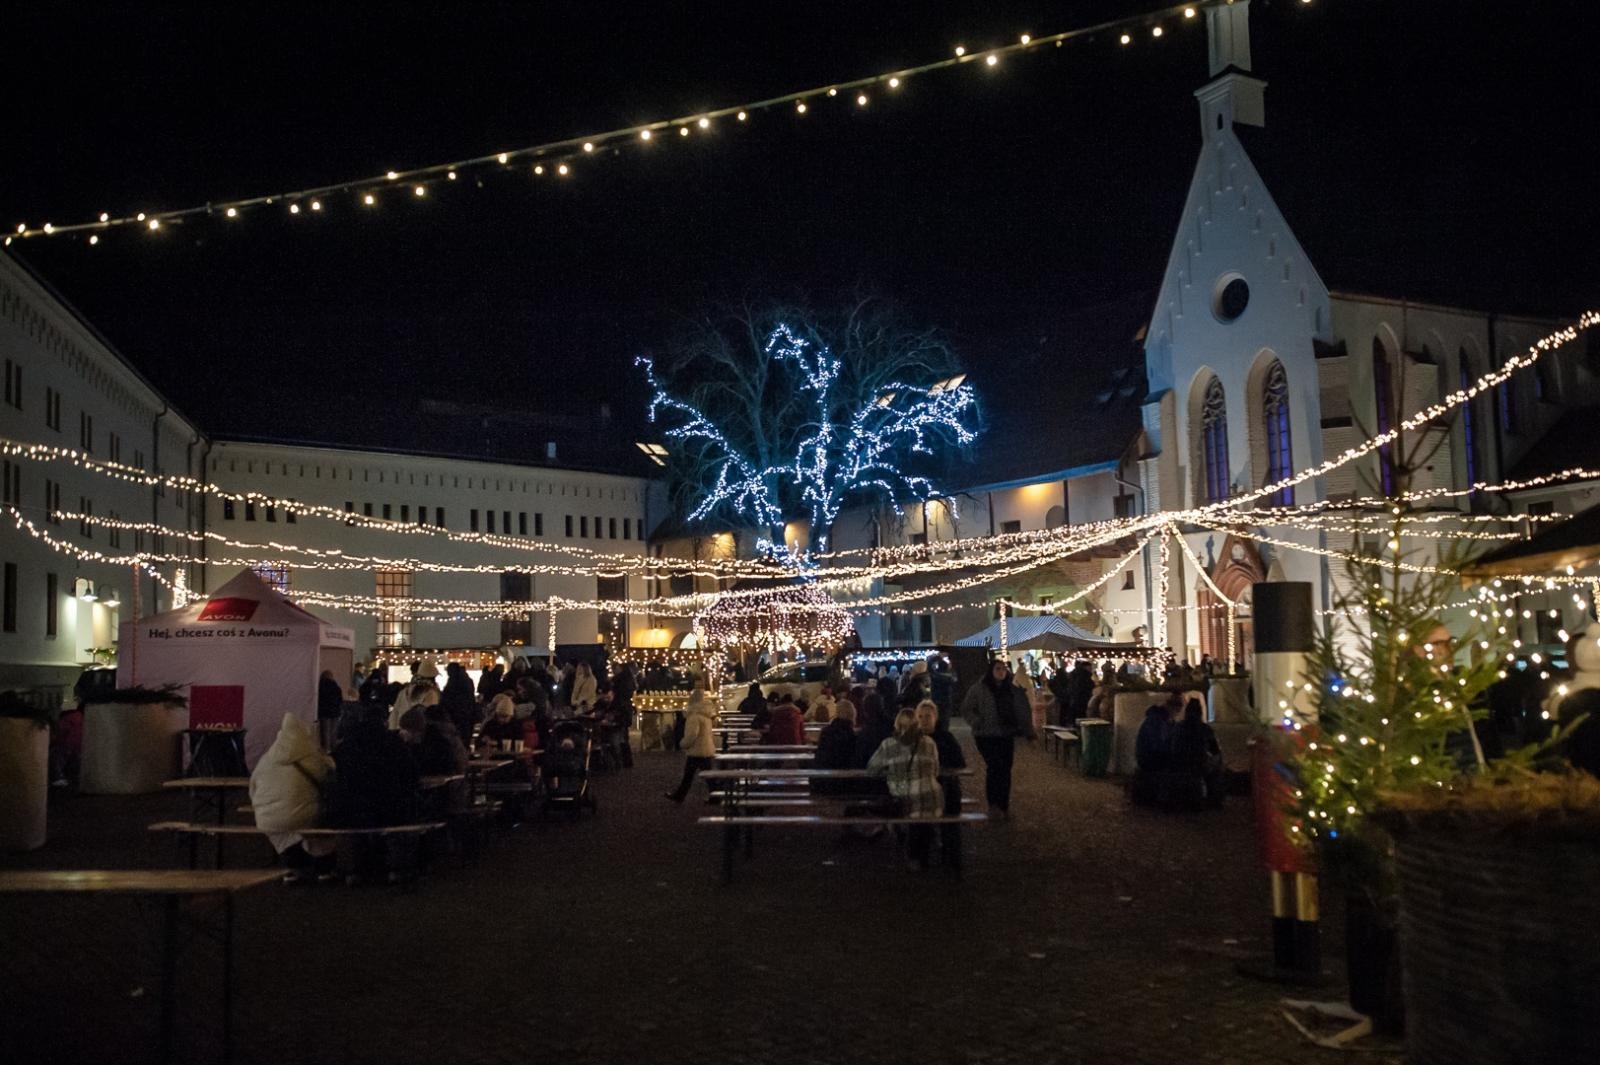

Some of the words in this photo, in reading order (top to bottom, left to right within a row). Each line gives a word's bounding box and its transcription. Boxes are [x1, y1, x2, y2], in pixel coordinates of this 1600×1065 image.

[175, 628, 214, 638] chcesz
[216, 628, 236, 638] coś
[239, 630, 245, 638] z
[195, 722, 238, 730] AVON
